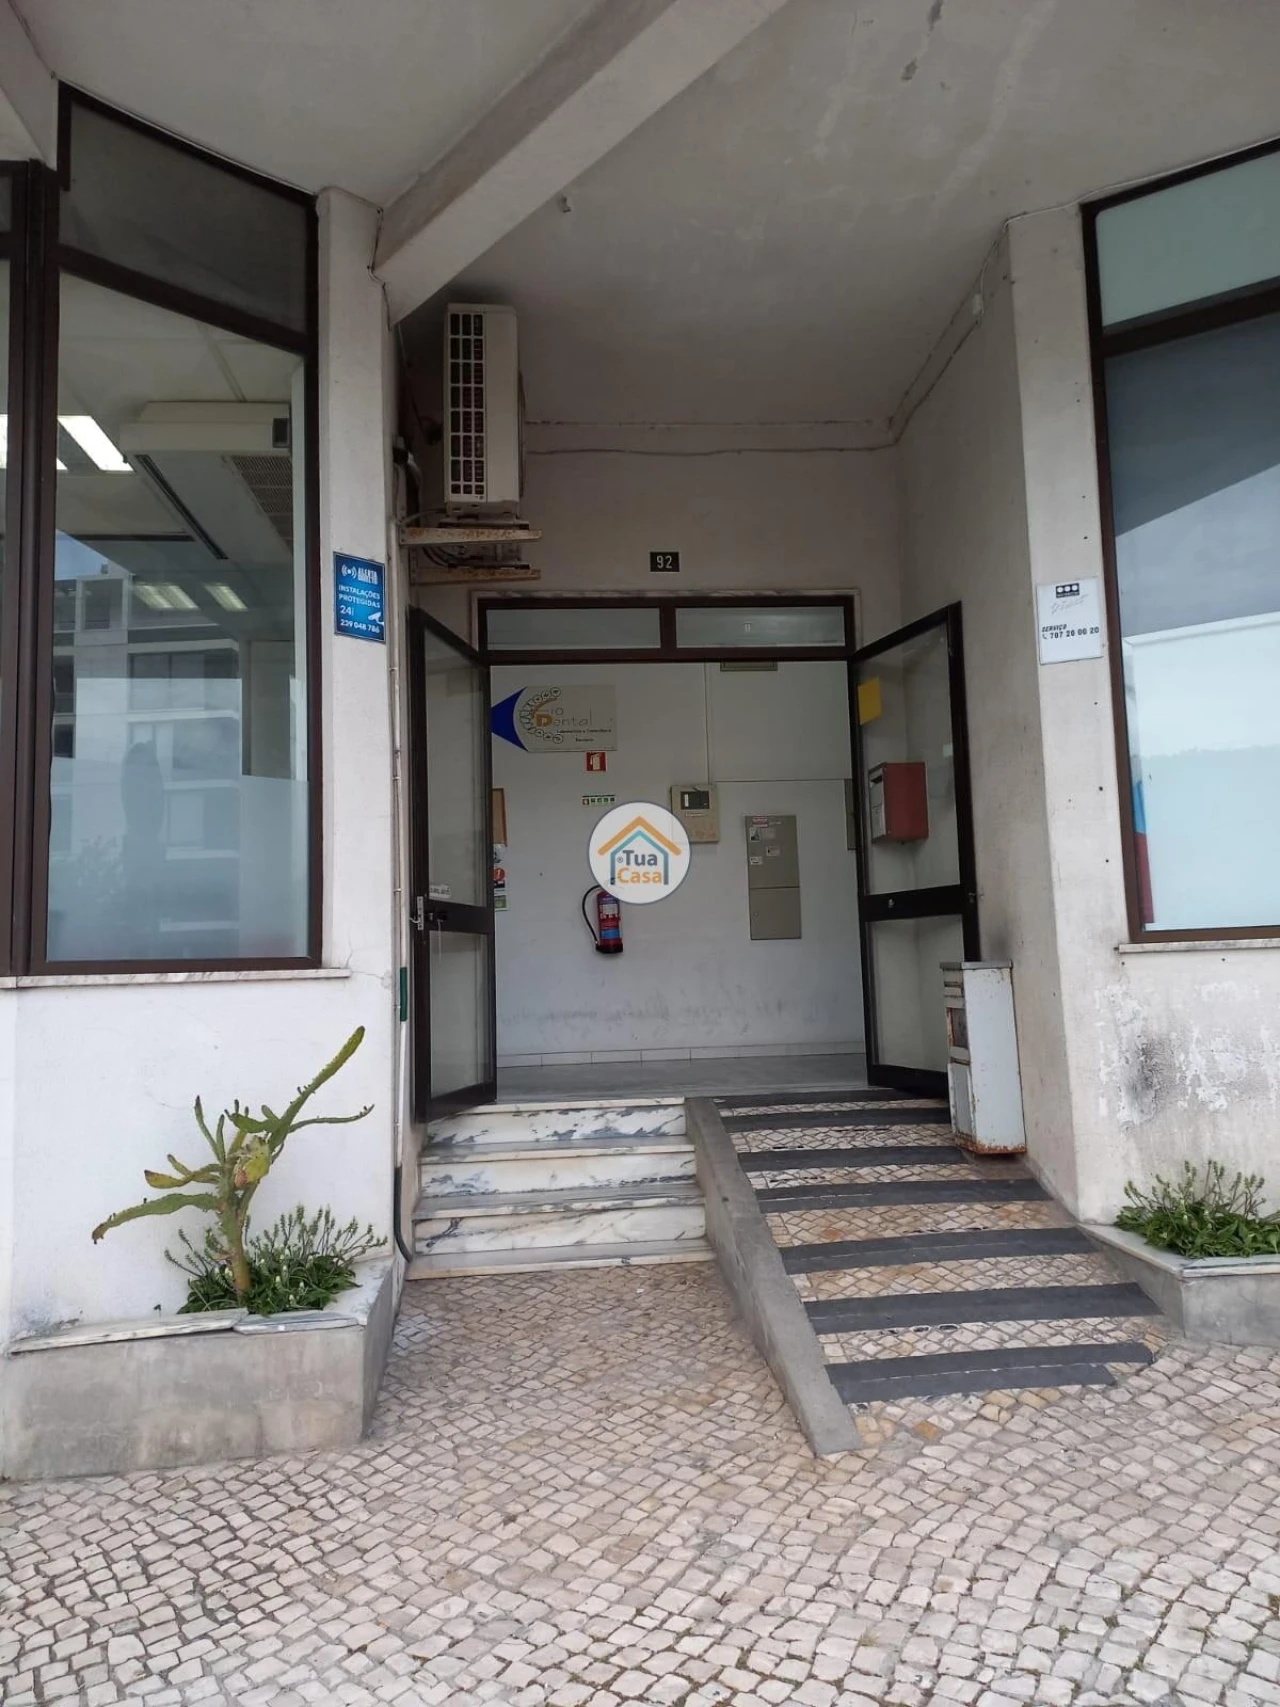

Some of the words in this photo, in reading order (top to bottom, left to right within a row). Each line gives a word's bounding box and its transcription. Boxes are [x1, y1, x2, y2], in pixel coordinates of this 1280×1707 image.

[656, 555, 673, 569] 92
[338, 584, 380, 600] INSTALAÇÕES
[338, 593, 380, 608] PROTEGIDAS
[340, 618, 353, 628] 239
[353, 621, 367, 631] 048
[1050, 631, 1064, 639] 707
[1066, 629, 1075, 638] 20
[1077, 628, 1087, 636] 00
[1090, 626, 1099, 634] 20
